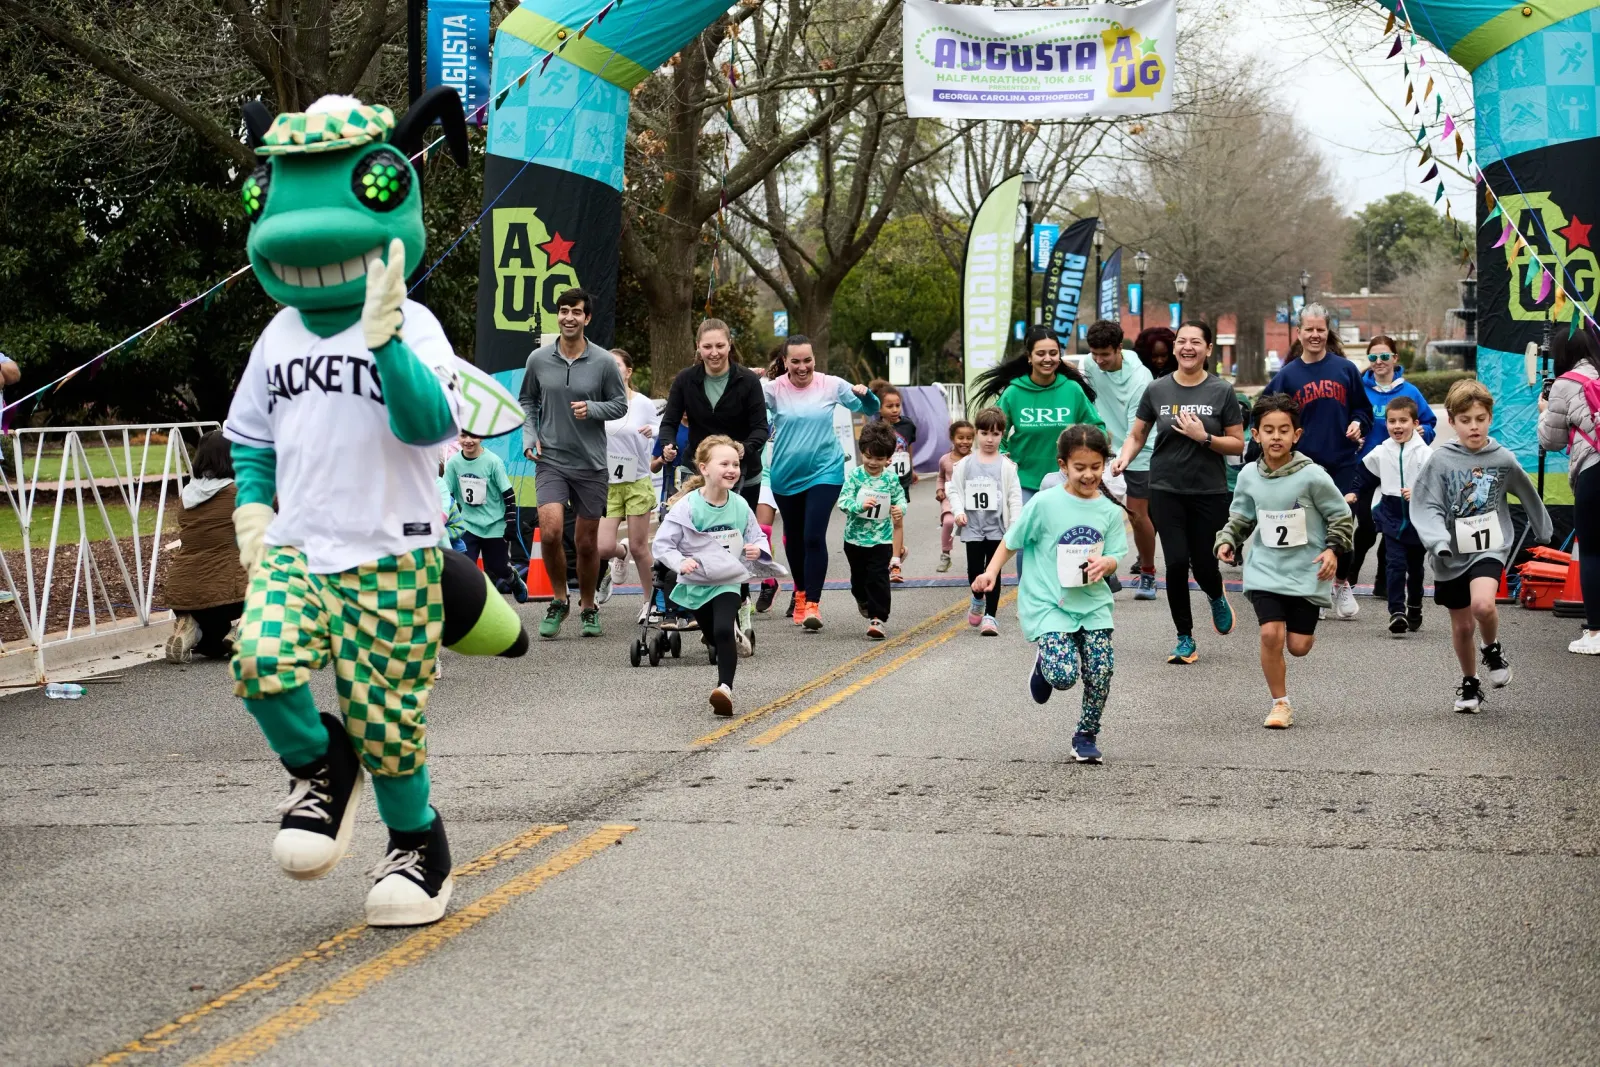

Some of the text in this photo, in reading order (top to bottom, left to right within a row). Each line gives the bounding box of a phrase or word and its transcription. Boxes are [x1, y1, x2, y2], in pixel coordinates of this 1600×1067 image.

[468, 17, 476, 110] UNIVERSITY
[934, 38, 1097, 73] AUGUSTA
[936, 73, 1093, 86] HALF MARATHON, 10K & 5K
[938, 92, 1089, 102] GEORGIA CAROLINA ORTHOPEDICS
[1046, 251, 1064, 301] SPORTS
[1019, 407, 1071, 423] SRP
[1180, 404, 1213, 416] REEVES
[613, 464, 624, 480] 4
[893, 461, 906, 475] 14
[465, 488, 474, 503] 3
[972, 492, 989, 509] 19
[867, 503, 882, 519] 11
[1063, 527, 1097, 541] MEDAL
[1275, 525, 1289, 546] 2
[1471, 528, 1491, 551] 17
[1078, 561, 1089, 585] 1
